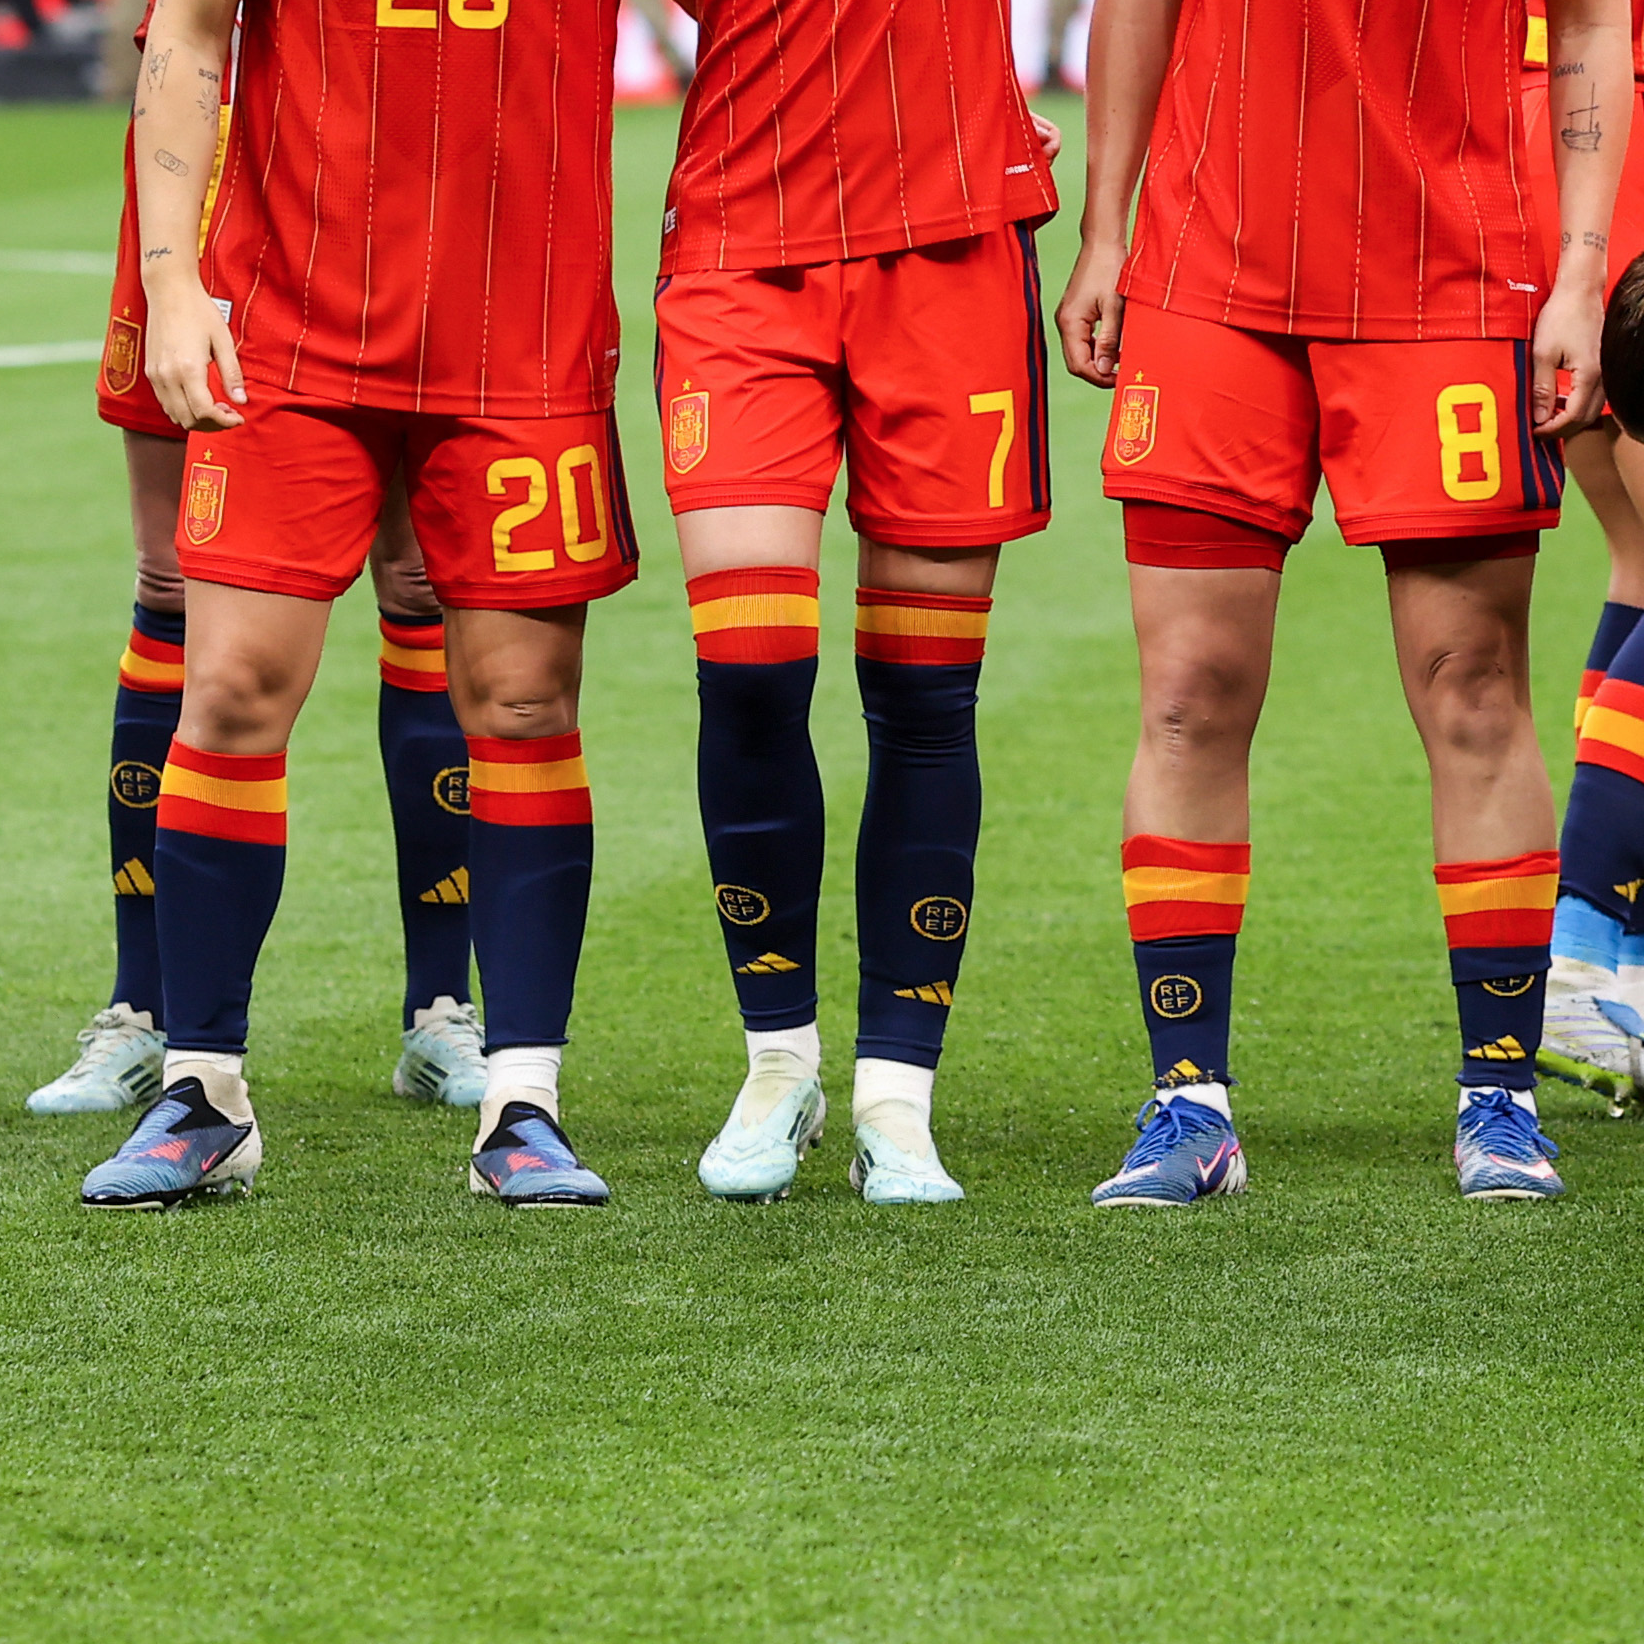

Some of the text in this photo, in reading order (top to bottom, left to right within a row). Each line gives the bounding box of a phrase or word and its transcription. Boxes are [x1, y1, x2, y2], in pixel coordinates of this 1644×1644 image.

[1437, 383, 1500, 501] 8
[969, 390, 1014, 508] 7
[486, 444, 608, 572] 20
[119, 771, 149, 783] RF
[121, 783, 152, 796] EF
[722, 892, 751, 904] RF
[727, 904, 755, 917] EF
[925, 905, 958, 918] RF
[925, 919, 956, 931] EF
[1160, 984, 1189, 997] RF
[1161, 996, 1191, 1009] EF
